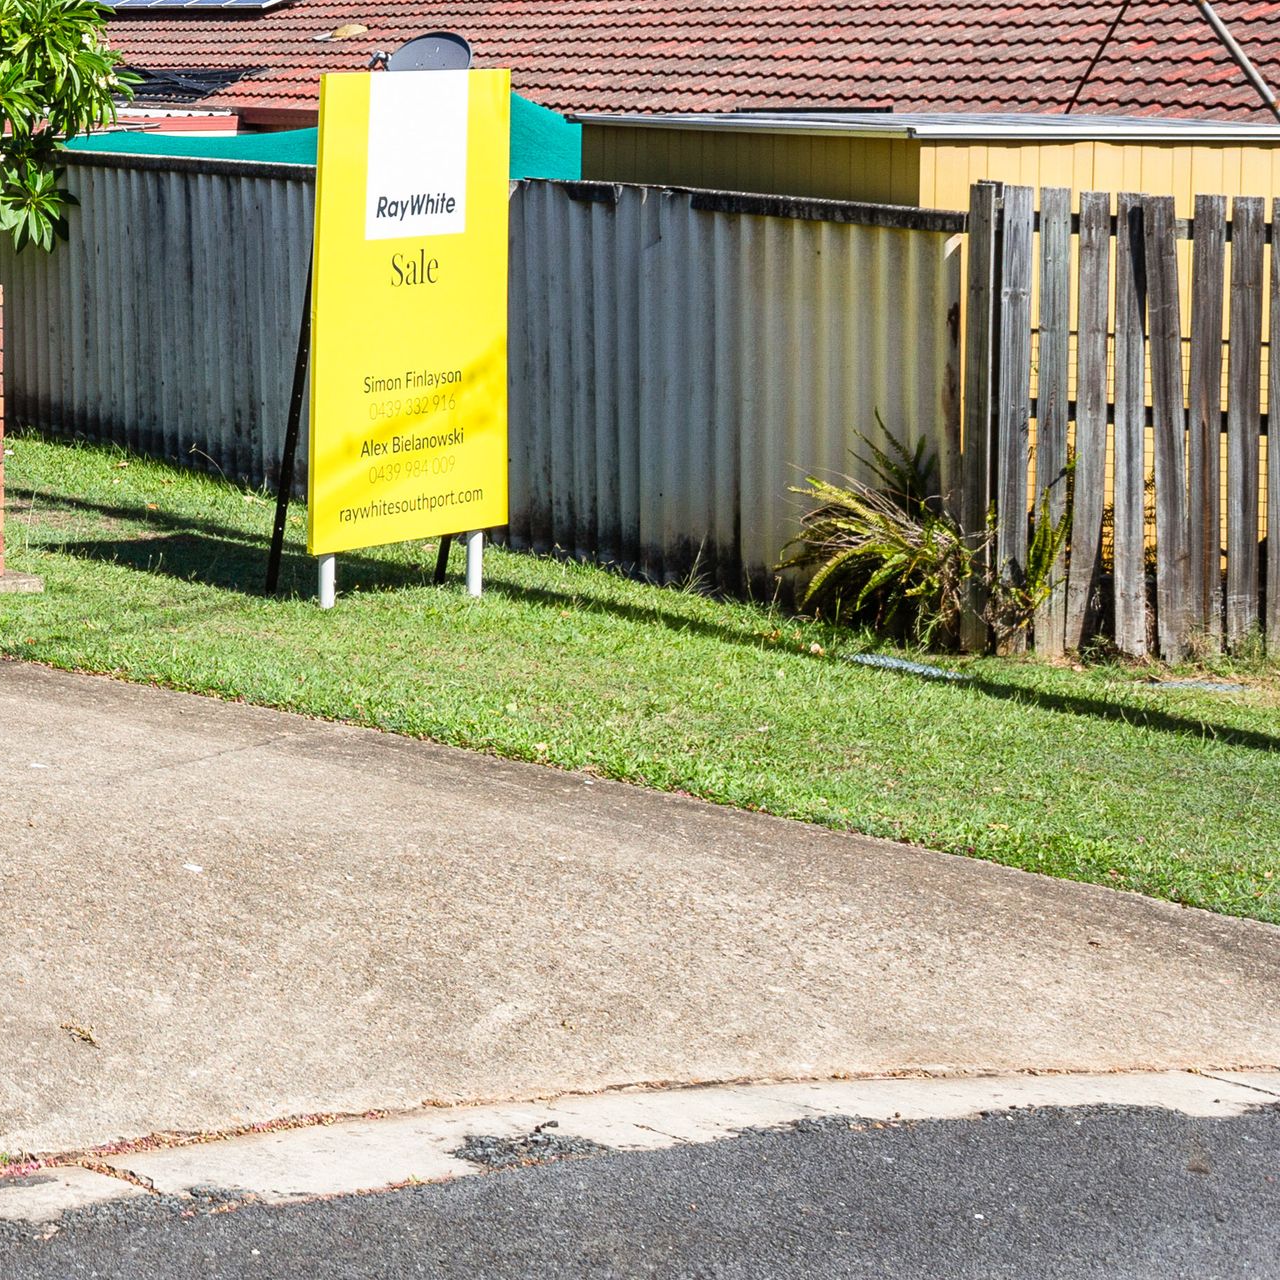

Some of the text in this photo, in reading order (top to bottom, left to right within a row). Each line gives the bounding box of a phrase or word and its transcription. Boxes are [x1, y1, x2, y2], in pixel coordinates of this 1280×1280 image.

[391, 248, 439, 287] Sale
[363, 369, 462, 394] Simon Finlayson
[369, 392, 456, 421] 0439 332 916
[360, 427, 464, 458] Alex Bielanowski
[368, 455, 456, 484] 0439 984 009
[339, 488, 483, 524] raywhitesouthport.com
